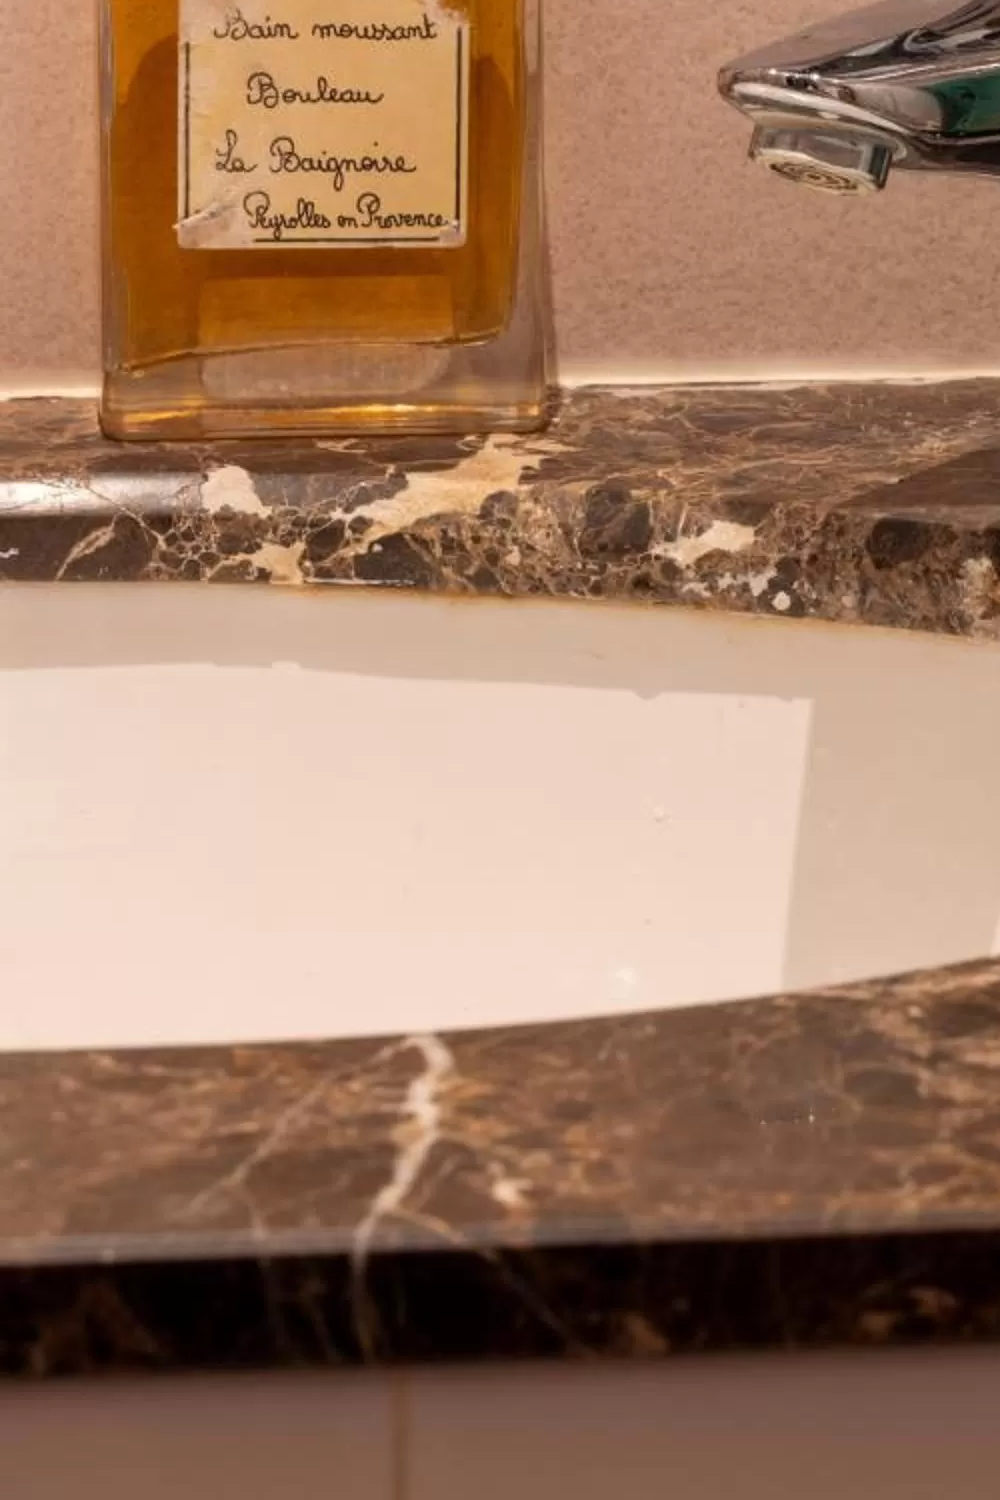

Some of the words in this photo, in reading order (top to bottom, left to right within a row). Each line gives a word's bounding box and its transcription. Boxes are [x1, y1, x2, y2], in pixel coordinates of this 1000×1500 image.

[214, 7, 300, 40] Bain
[312, 13, 438, 41] moussant
[246, 71, 385, 109] Bouleau
[215, 128, 259, 173] La
[268, 135, 417, 192] Baignoire
[243, 190, 331, 241] Peyrolles
[337, 215, 358, 229] en
[356, 192, 449, 229] Provence
